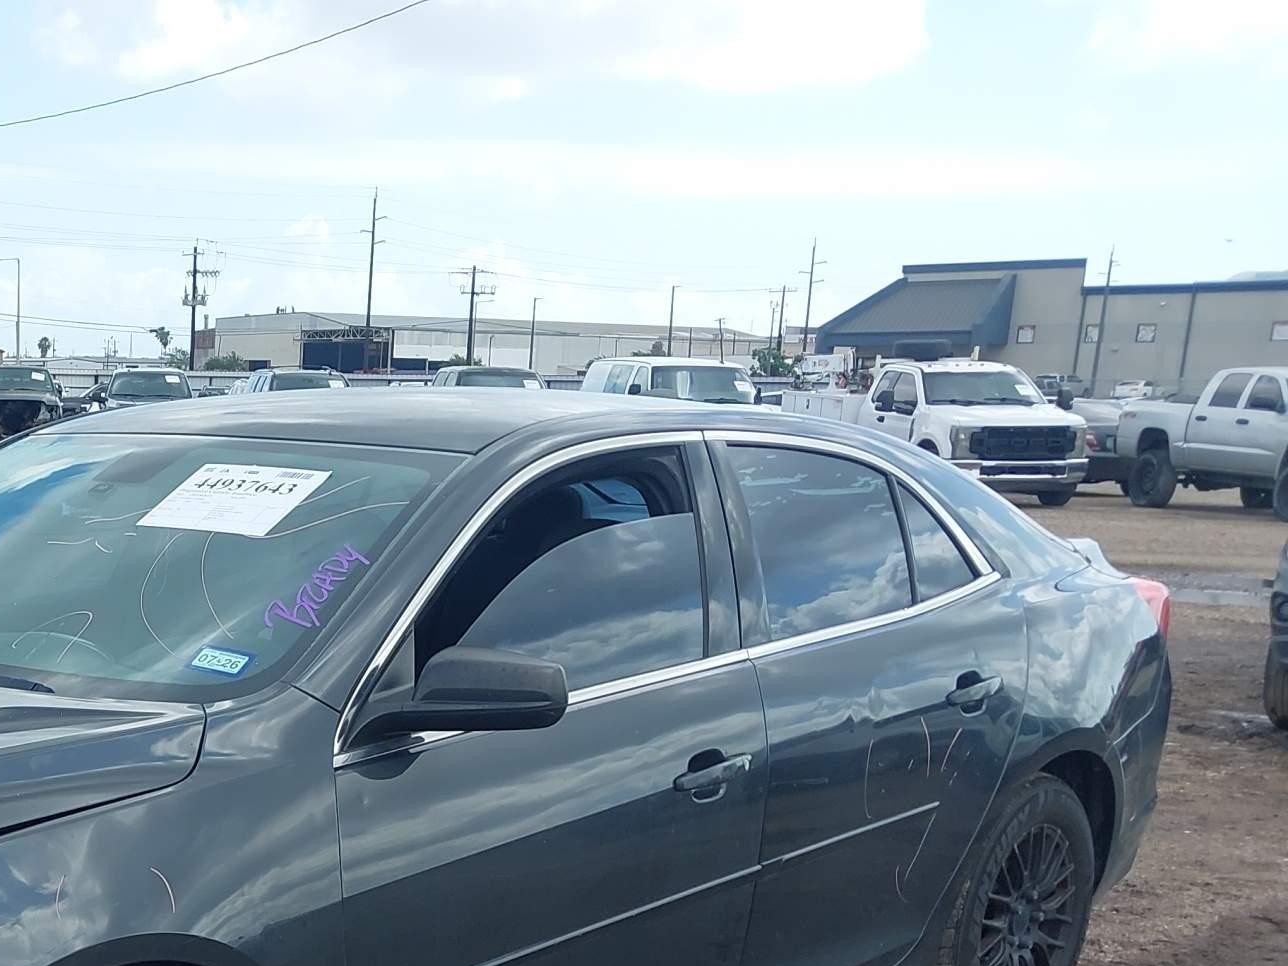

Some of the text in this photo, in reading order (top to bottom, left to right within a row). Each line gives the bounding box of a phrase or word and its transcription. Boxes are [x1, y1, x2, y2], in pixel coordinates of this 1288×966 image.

[194, 478, 298, 496] 44937643
[198, 653, 218, 664] 07
[222, 658, 241, 669] 26
